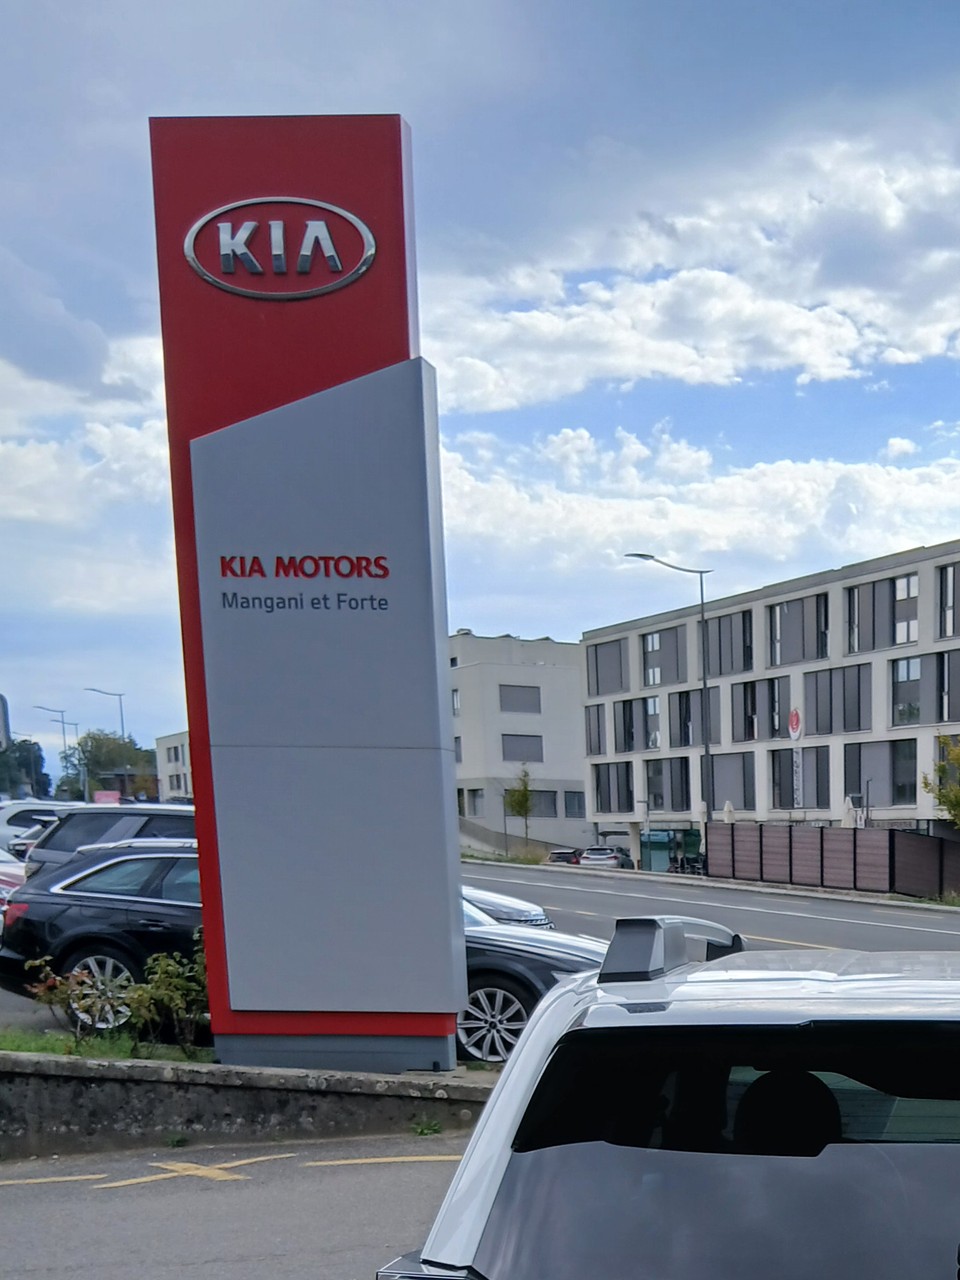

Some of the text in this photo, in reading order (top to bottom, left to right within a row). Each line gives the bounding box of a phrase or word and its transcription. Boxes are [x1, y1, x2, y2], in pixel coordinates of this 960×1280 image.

[217, 220, 343, 274] KIA
[219, 555, 390, 579] KIA MOTORS
[221, 592, 389, 613] Mangani et Forte
